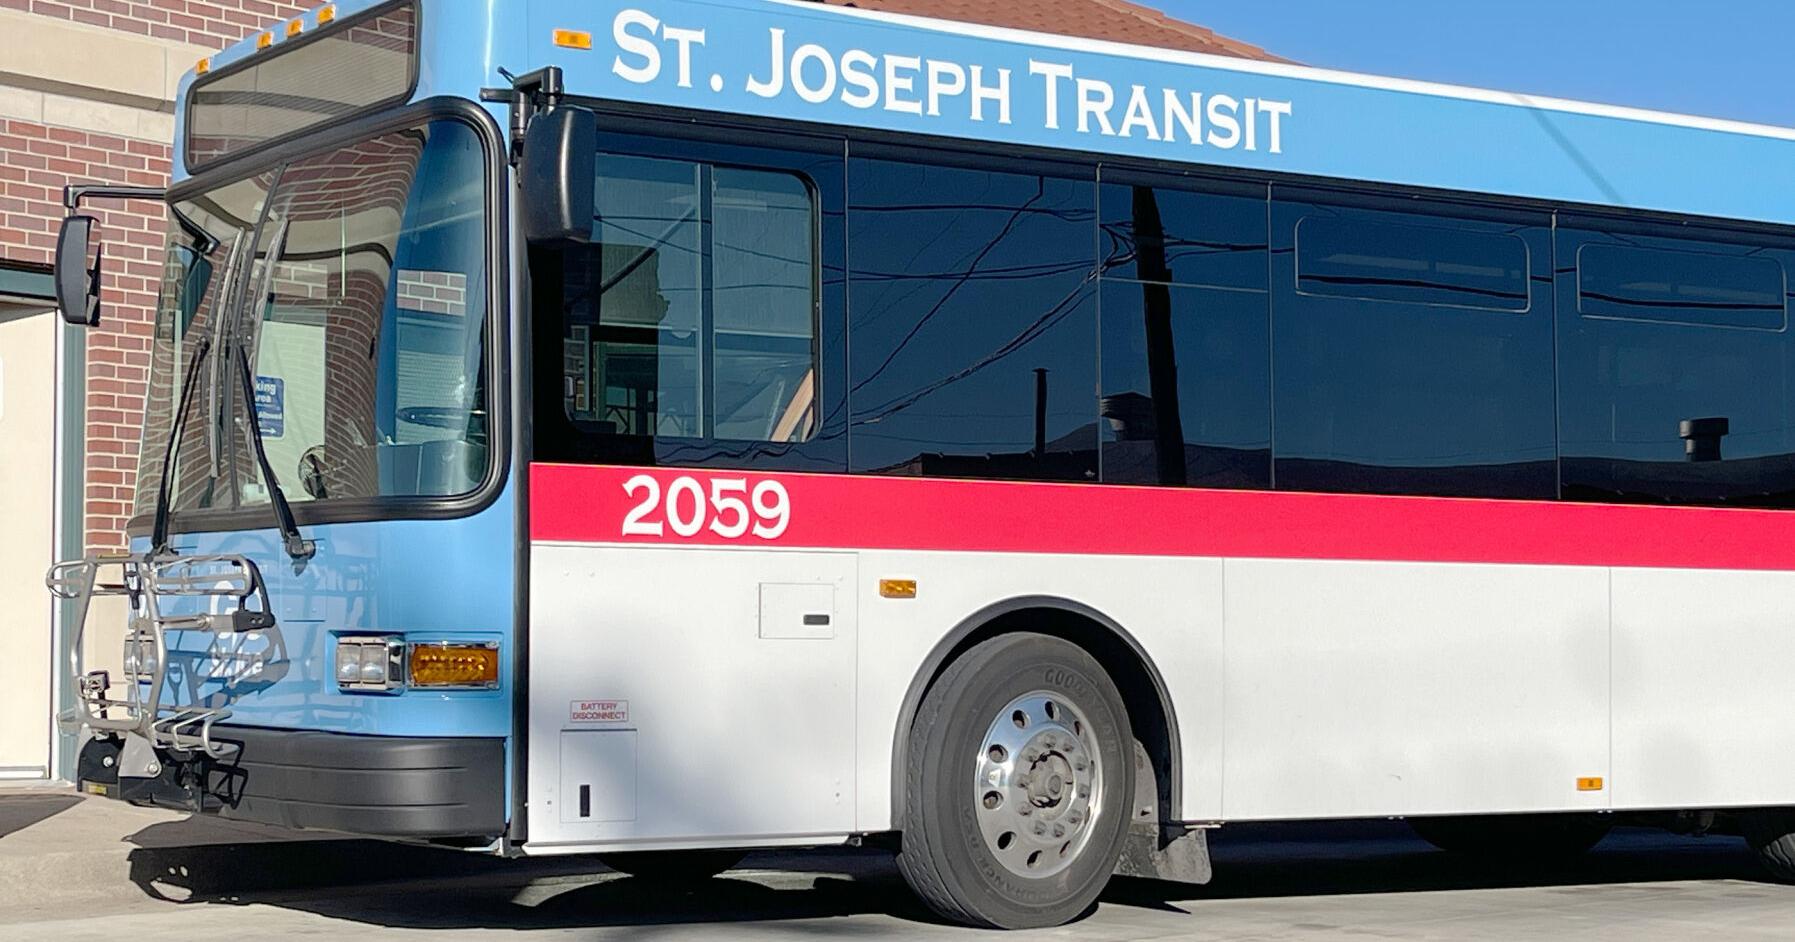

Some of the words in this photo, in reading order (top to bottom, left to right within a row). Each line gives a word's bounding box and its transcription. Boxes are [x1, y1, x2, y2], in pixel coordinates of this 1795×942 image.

[745, 27, 1012, 124] JOSEPH
[1028, 58, 1292, 153] TRANSIT
[622, 474, 791, 540] 2059
[572, 711, 626, 720] DISCONNECT
[581, 702, 617, 711] BATTERY
